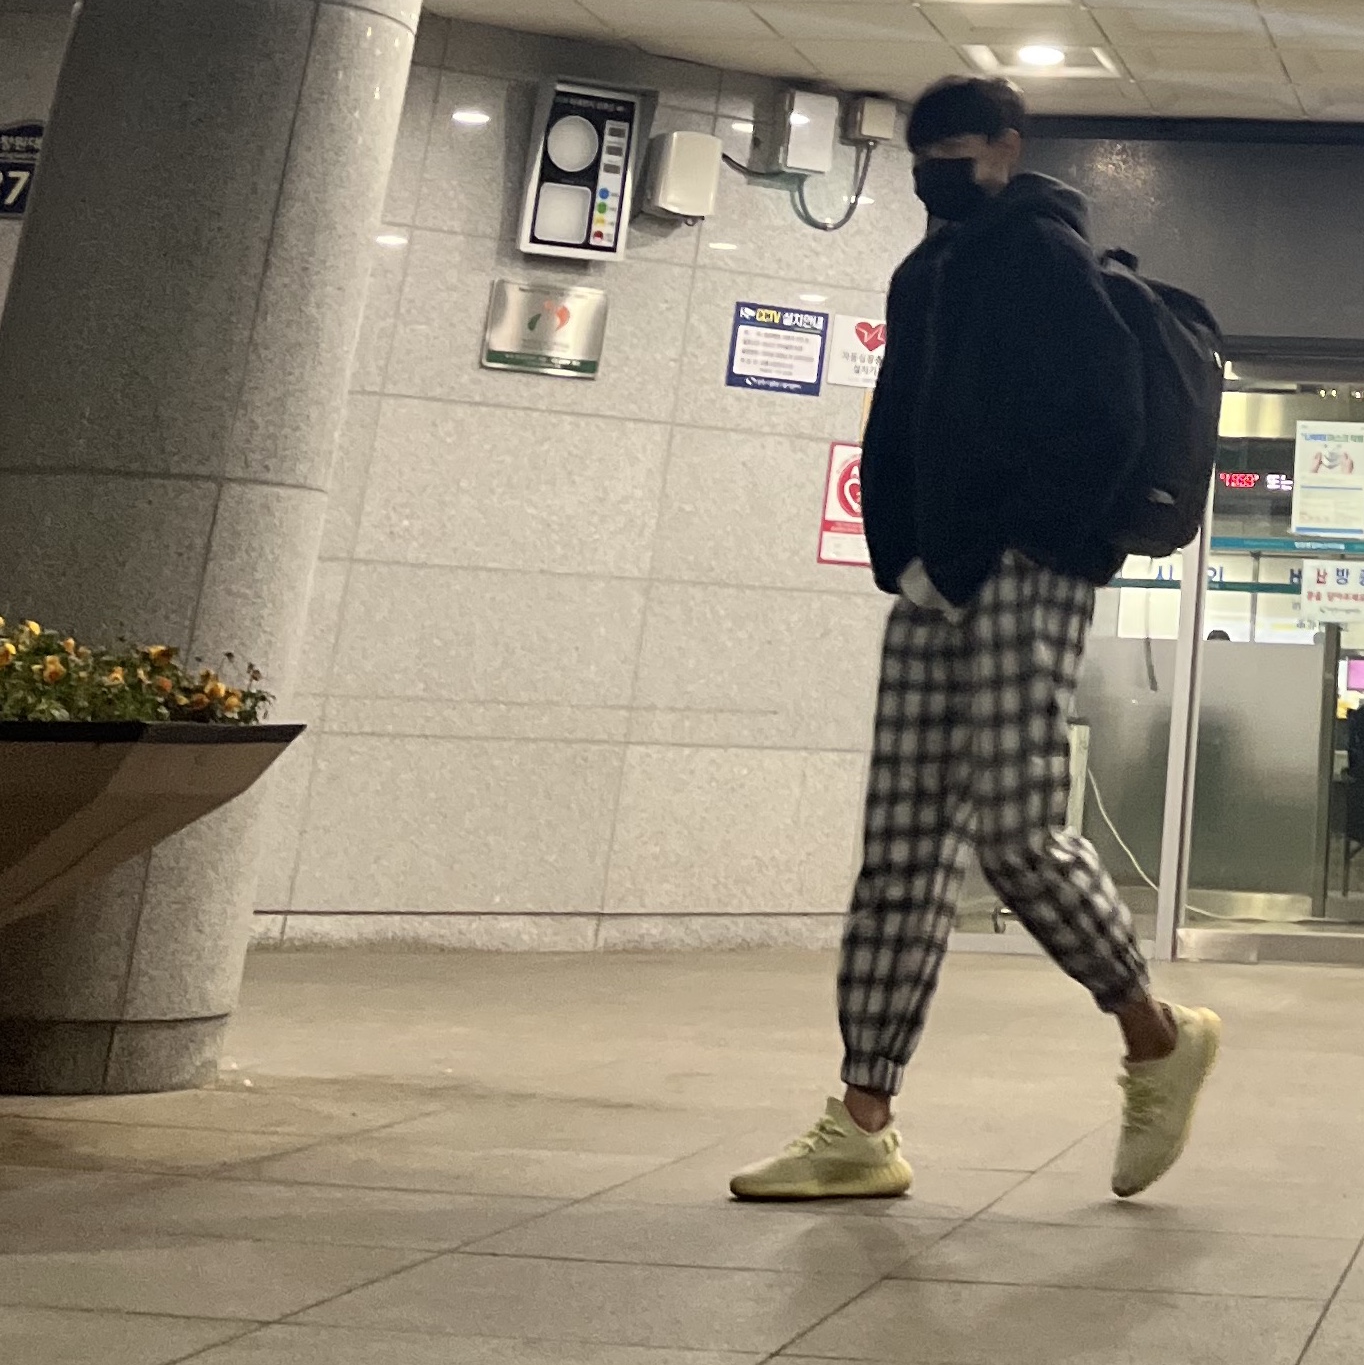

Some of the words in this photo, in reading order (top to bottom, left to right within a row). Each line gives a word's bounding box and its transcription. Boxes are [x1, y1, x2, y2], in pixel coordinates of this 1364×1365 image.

[0, 170, 30, 205] 7
[755, 308, 781, 324] CCTV
[782, 312, 824, 330] 설치안내
